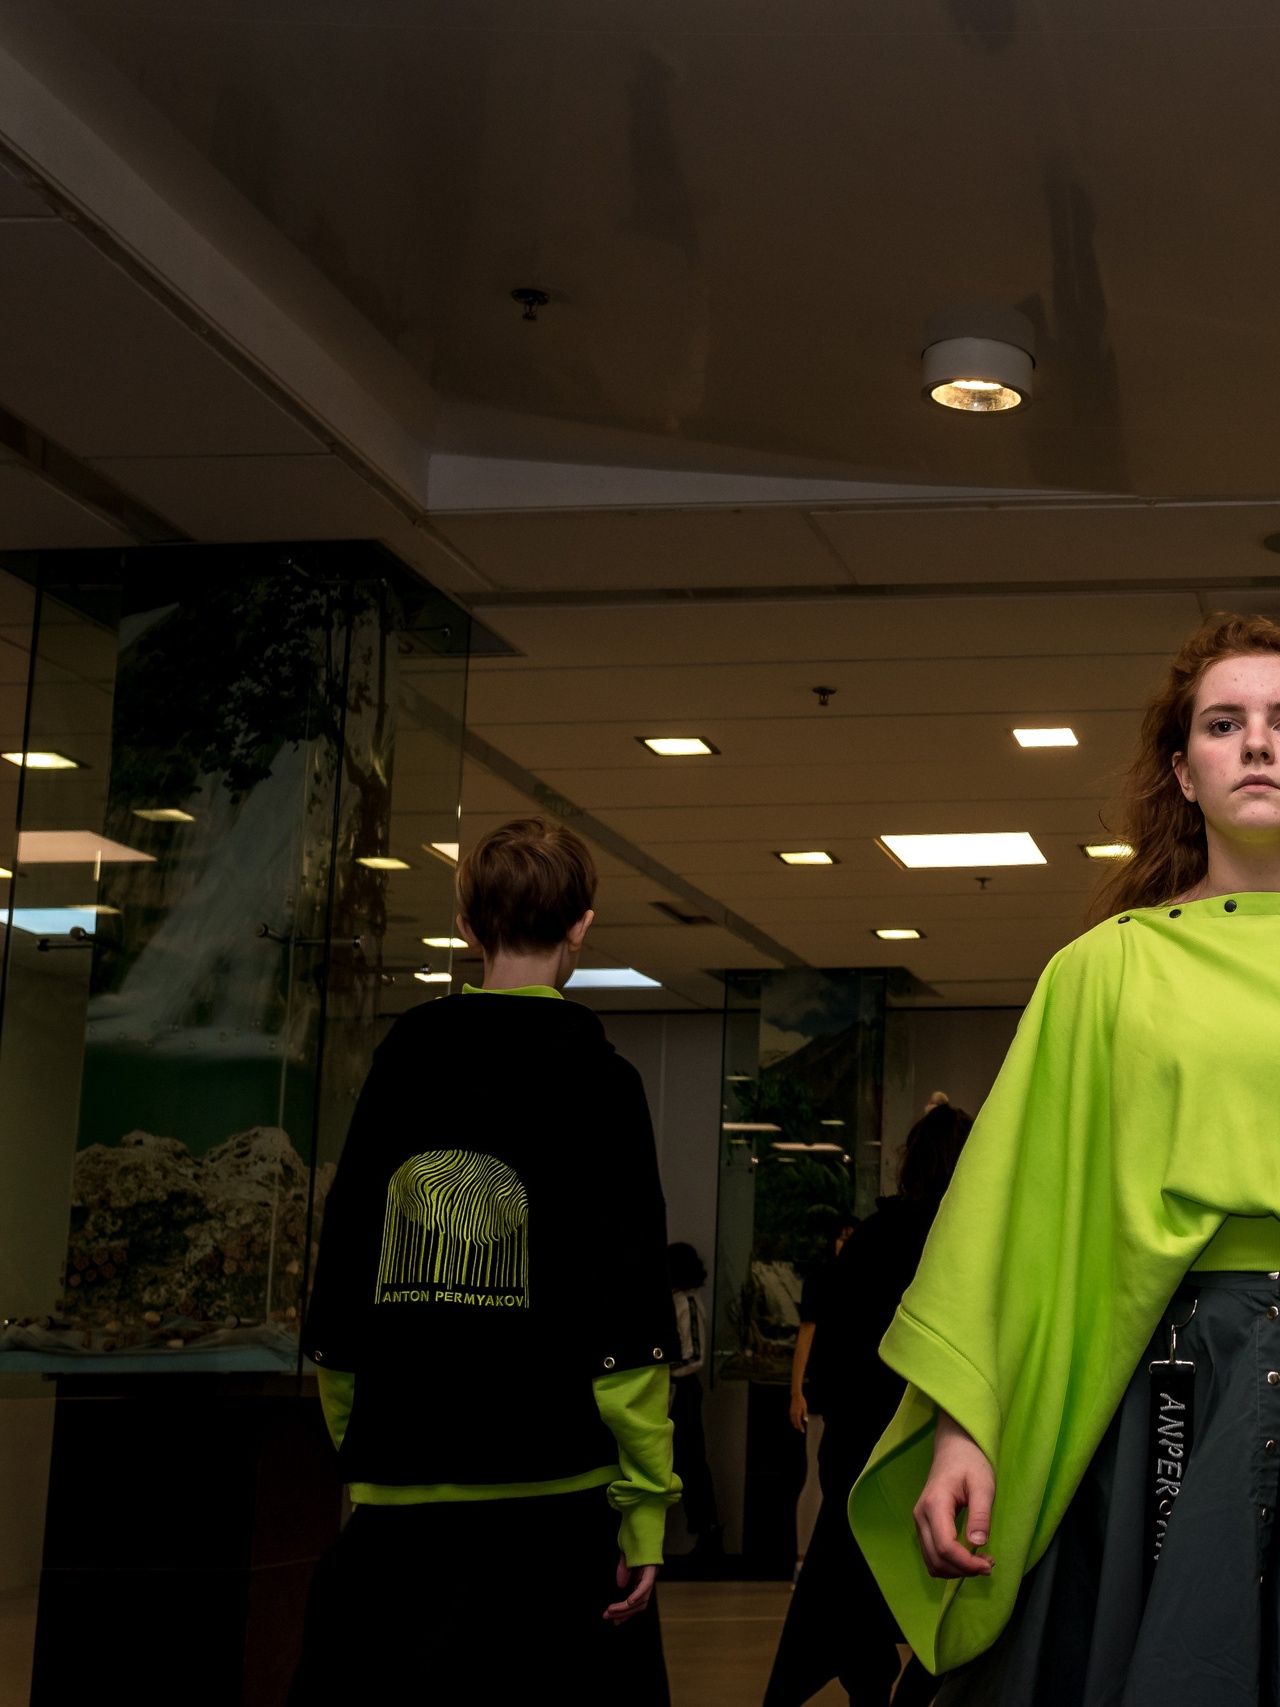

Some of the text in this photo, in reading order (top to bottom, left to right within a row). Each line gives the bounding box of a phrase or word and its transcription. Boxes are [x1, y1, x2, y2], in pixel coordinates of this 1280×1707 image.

[382, 1290, 524, 1307] ANTON PERMYAKOV
[1156, 1392, 1186, 1497] ANPER
